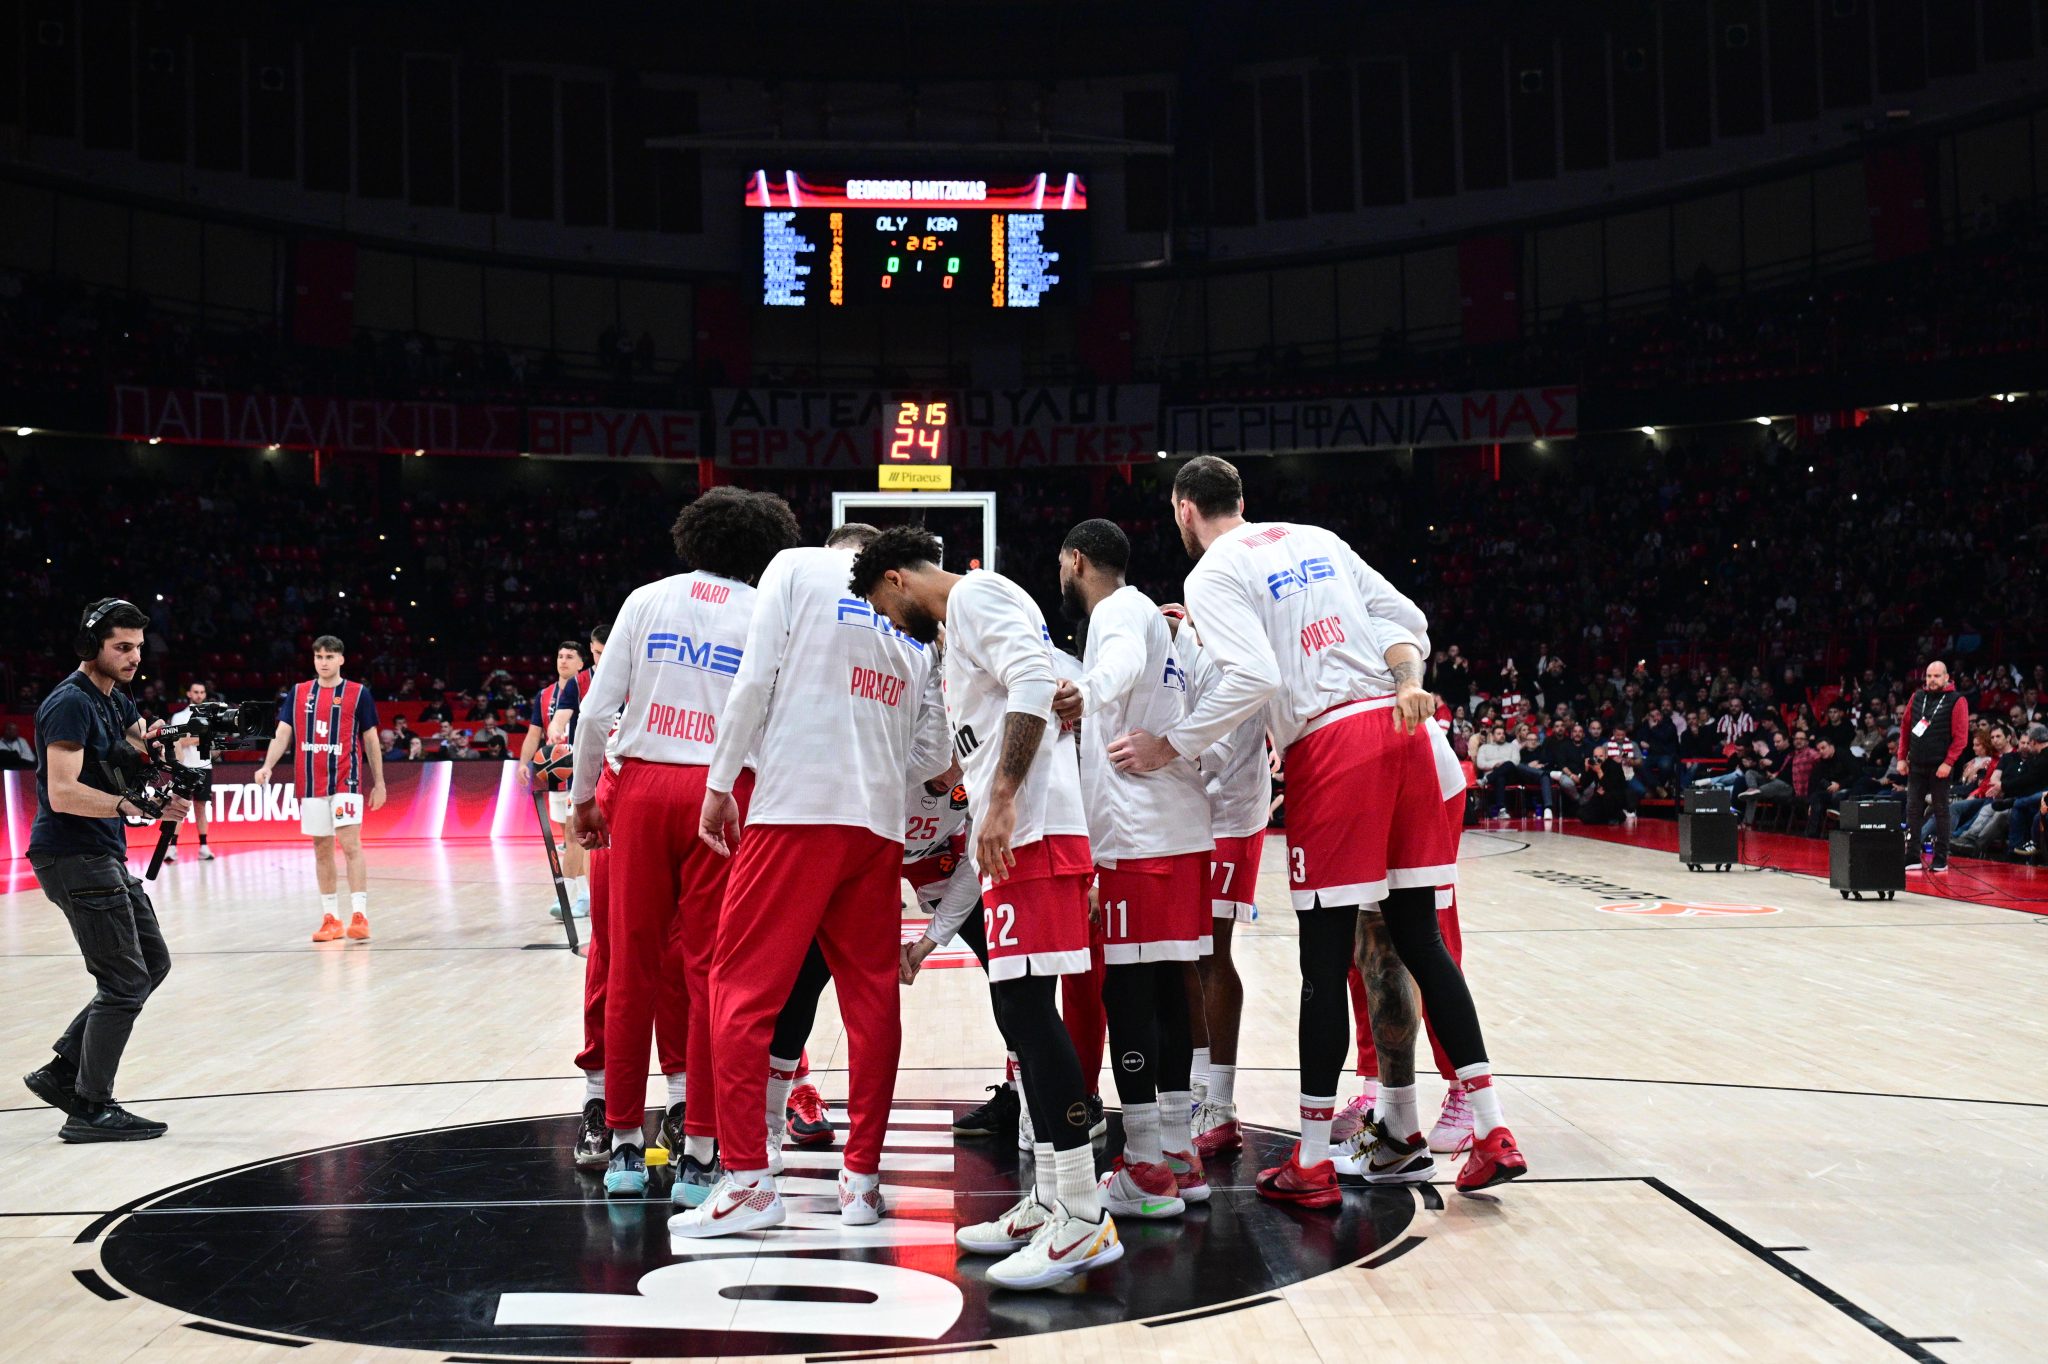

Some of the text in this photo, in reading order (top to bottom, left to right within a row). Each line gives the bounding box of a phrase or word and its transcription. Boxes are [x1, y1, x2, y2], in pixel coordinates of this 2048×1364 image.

[876, 216, 958, 231] OLY KBA
[887, 257, 900, 273] 0
[947, 257, 960, 273] 0
[881, 275, 953, 289] 0 0
[890, 427, 940, 460] 24
[901, 471, 942, 484] Piraeus
[1267, 556, 1337, 601] FMS
[690, 581, 731, 605] WARD
[647, 633, 744, 675] FMS
[316, 720, 328, 737] 4
[647, 703, 716, 745] PIRAEUS
[301, 741, 343, 756] kingroyal
[345, 802, 356, 818] 4
[905, 815, 939, 840] 25
[1287, 847, 1306, 883] 3
[984, 903, 1018, 950] 22
[1104, 900, 1128, 939] 11
